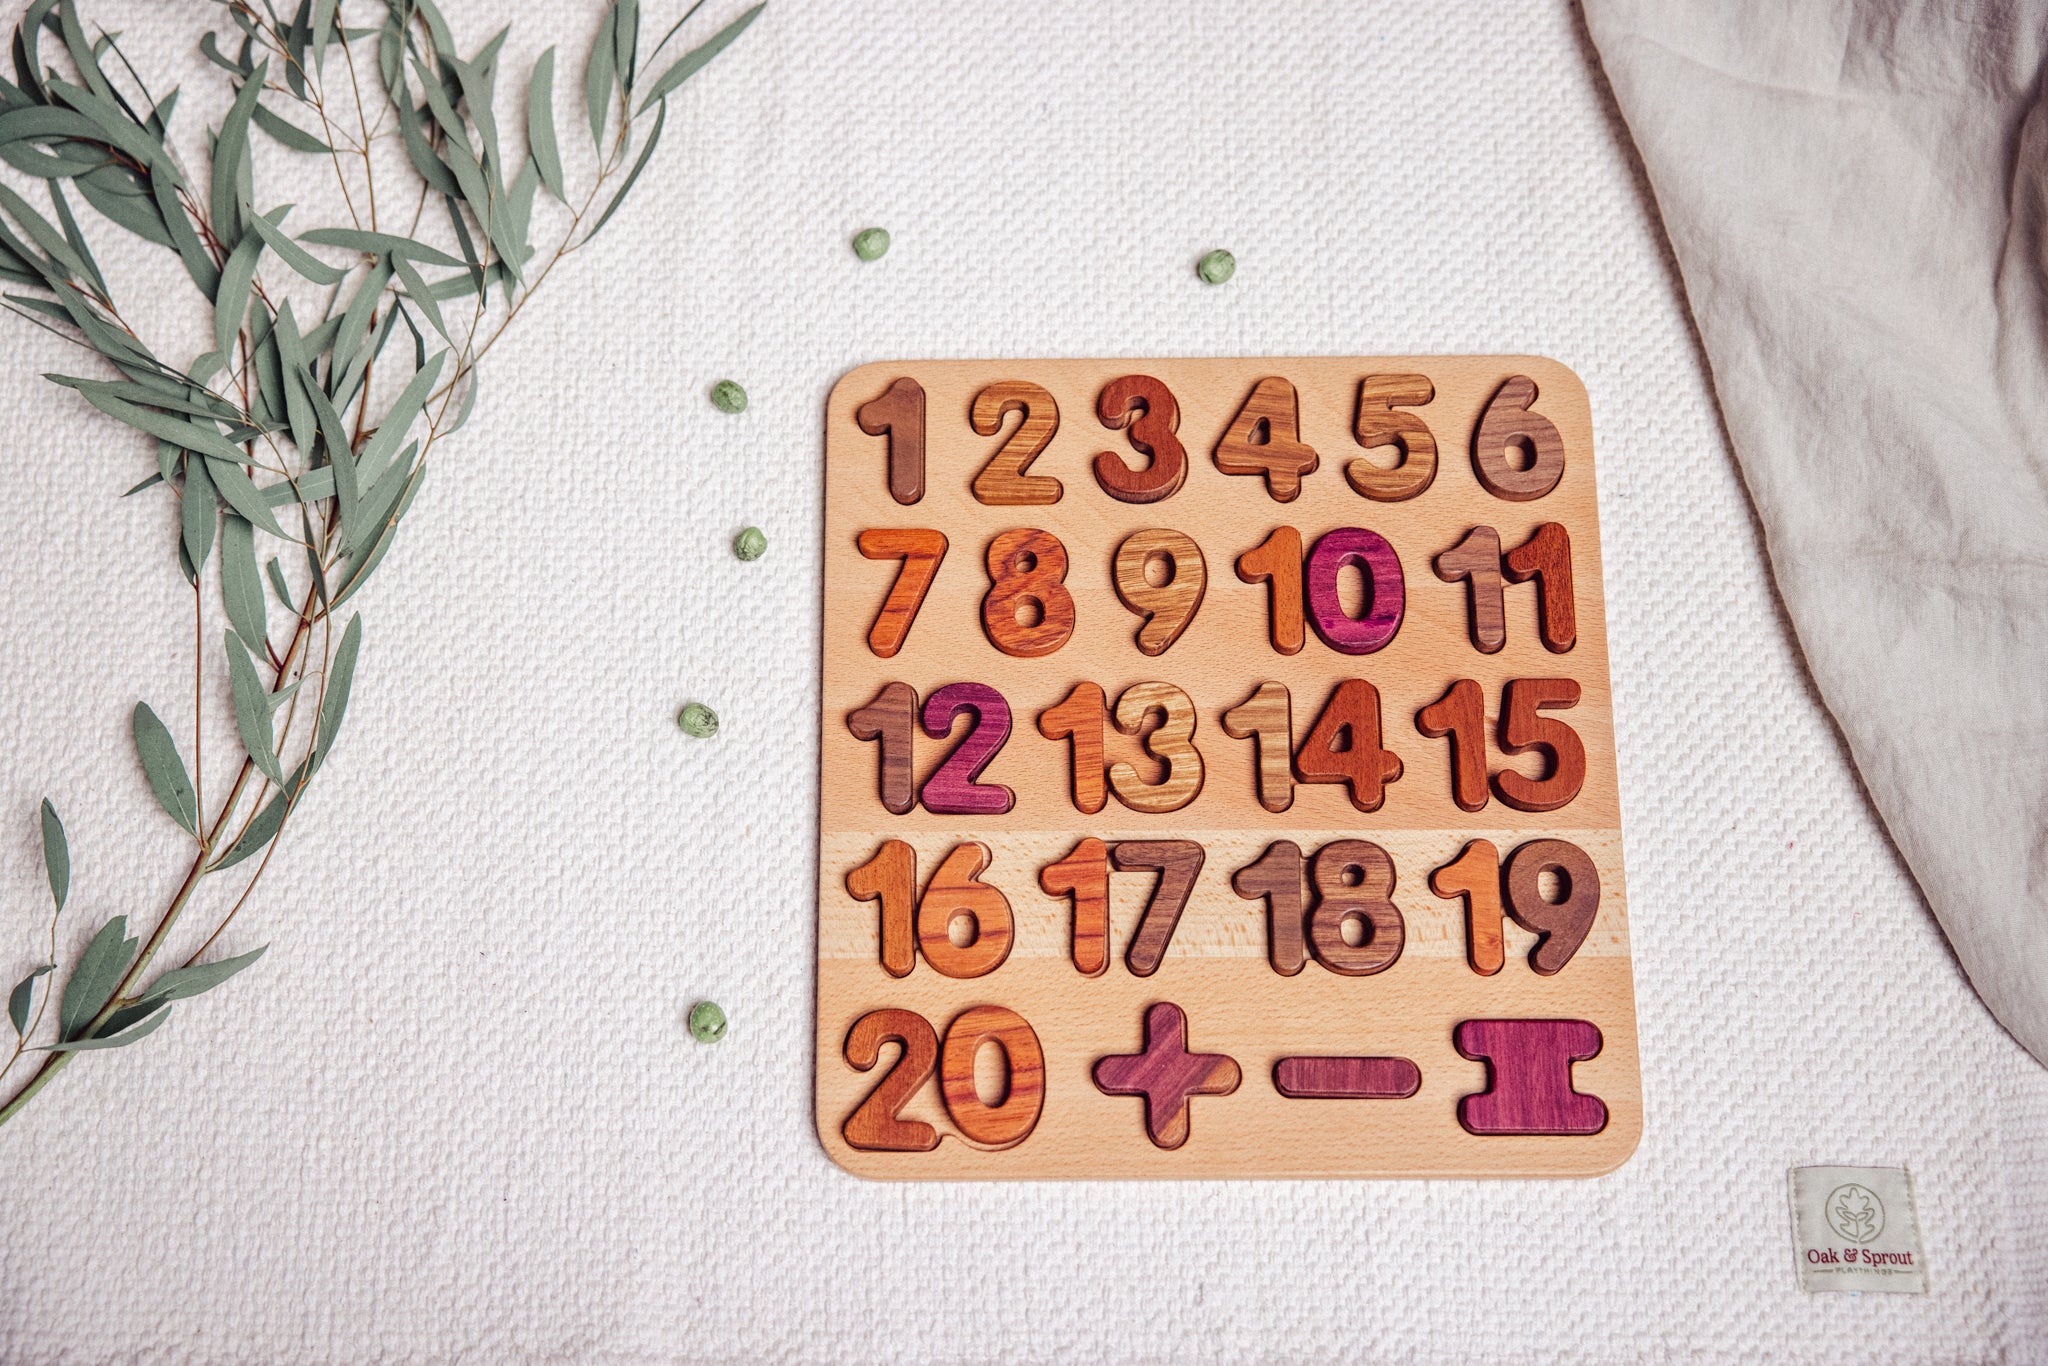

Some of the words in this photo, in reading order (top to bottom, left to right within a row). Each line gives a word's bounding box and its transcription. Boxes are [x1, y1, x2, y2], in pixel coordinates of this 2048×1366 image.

[857, 376, 926, 506] 1
[970, 381, 1064, 505] 2
[1094, 374, 1188, 504] 3
[1212, 376, 1319, 503] 4
[1344, 374, 1438, 501] 5
[1471, 374, 1564, 501] 6
[857, 528, 949, 658] 7
[981, 528, 1076, 657] 8
[1114, 528, 1208, 656] 9
[1235, 526, 1406, 655] 10
[1433, 522, 1576, 654] 11
[847, 681, 1016, 815] 12
[1037, 681, 1205, 814] 13
[1221, 678, 1404, 813] 14
[1414, 678, 1586, 812] 15
[846, 839, 1015, 979] 16
[1039, 837, 1206, 978] 17
[1232, 839, 1405, 976] 18
[1429, 838, 1600, 976] 19
[843, 1005, 1045, 1151] 20
[1807, 1248, 1840, 1264] Oak
[1843, 1248, 1858, 1263] &
[1861, 1248, 1913, 1267] Sprout
[1835, 1267, 1893, 1276] PLAYTHINGS
